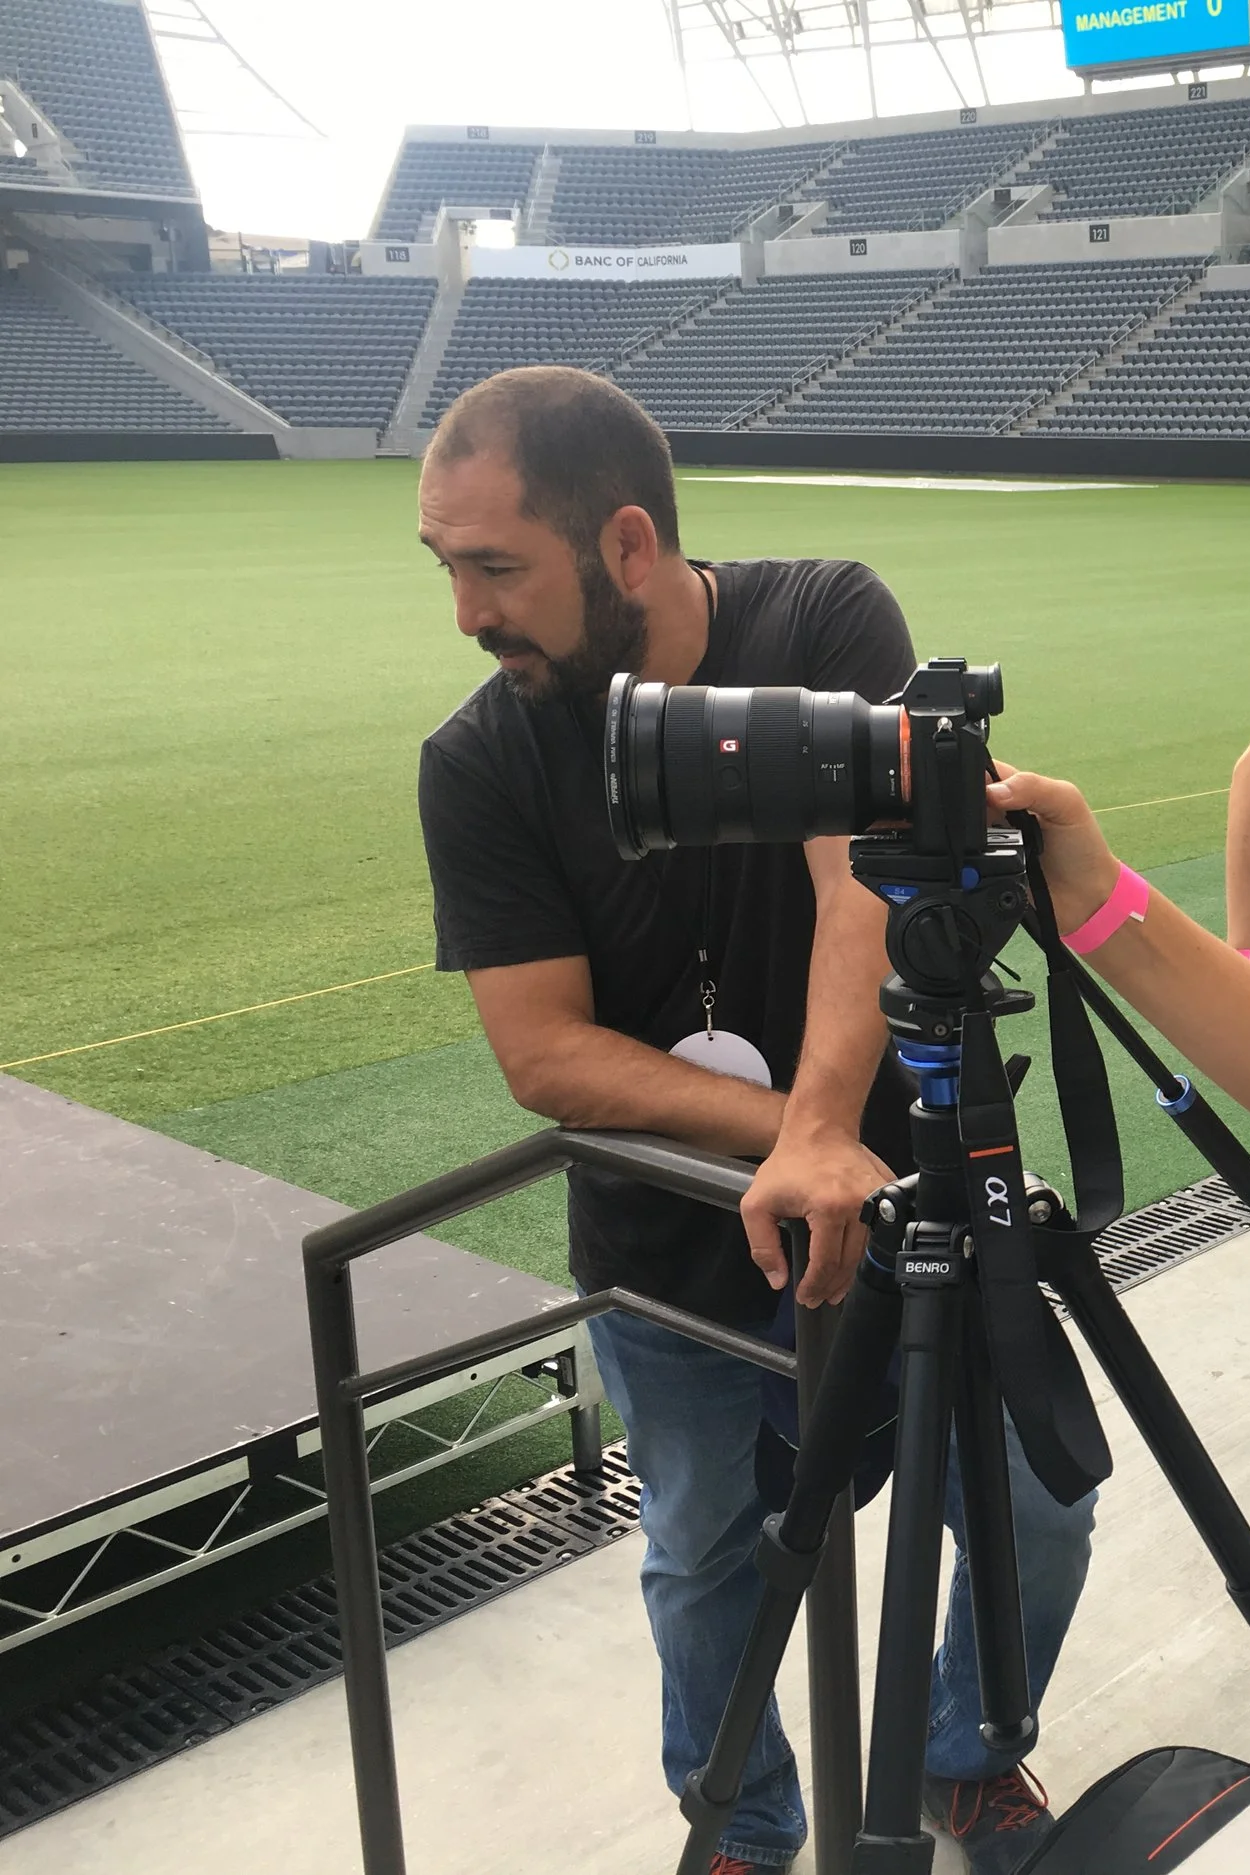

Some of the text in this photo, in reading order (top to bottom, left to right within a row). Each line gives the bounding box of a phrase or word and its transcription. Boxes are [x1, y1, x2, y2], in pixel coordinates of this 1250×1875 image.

[1076, 1, 1188, 32] MANAGEMENT
[1190, 86, 1206, 98] 221
[961, 112, 976, 122] 220
[637, 132, 655, 142] 219
[1092, 228, 1107, 241] 121
[851, 243, 866, 254] 120
[389, 250, 407, 261] 118
[575, 254, 688, 267] BANC OF CALIFORNIA
[724, 740, 736, 752] G
[905, 1261, 950, 1275] BENRO
